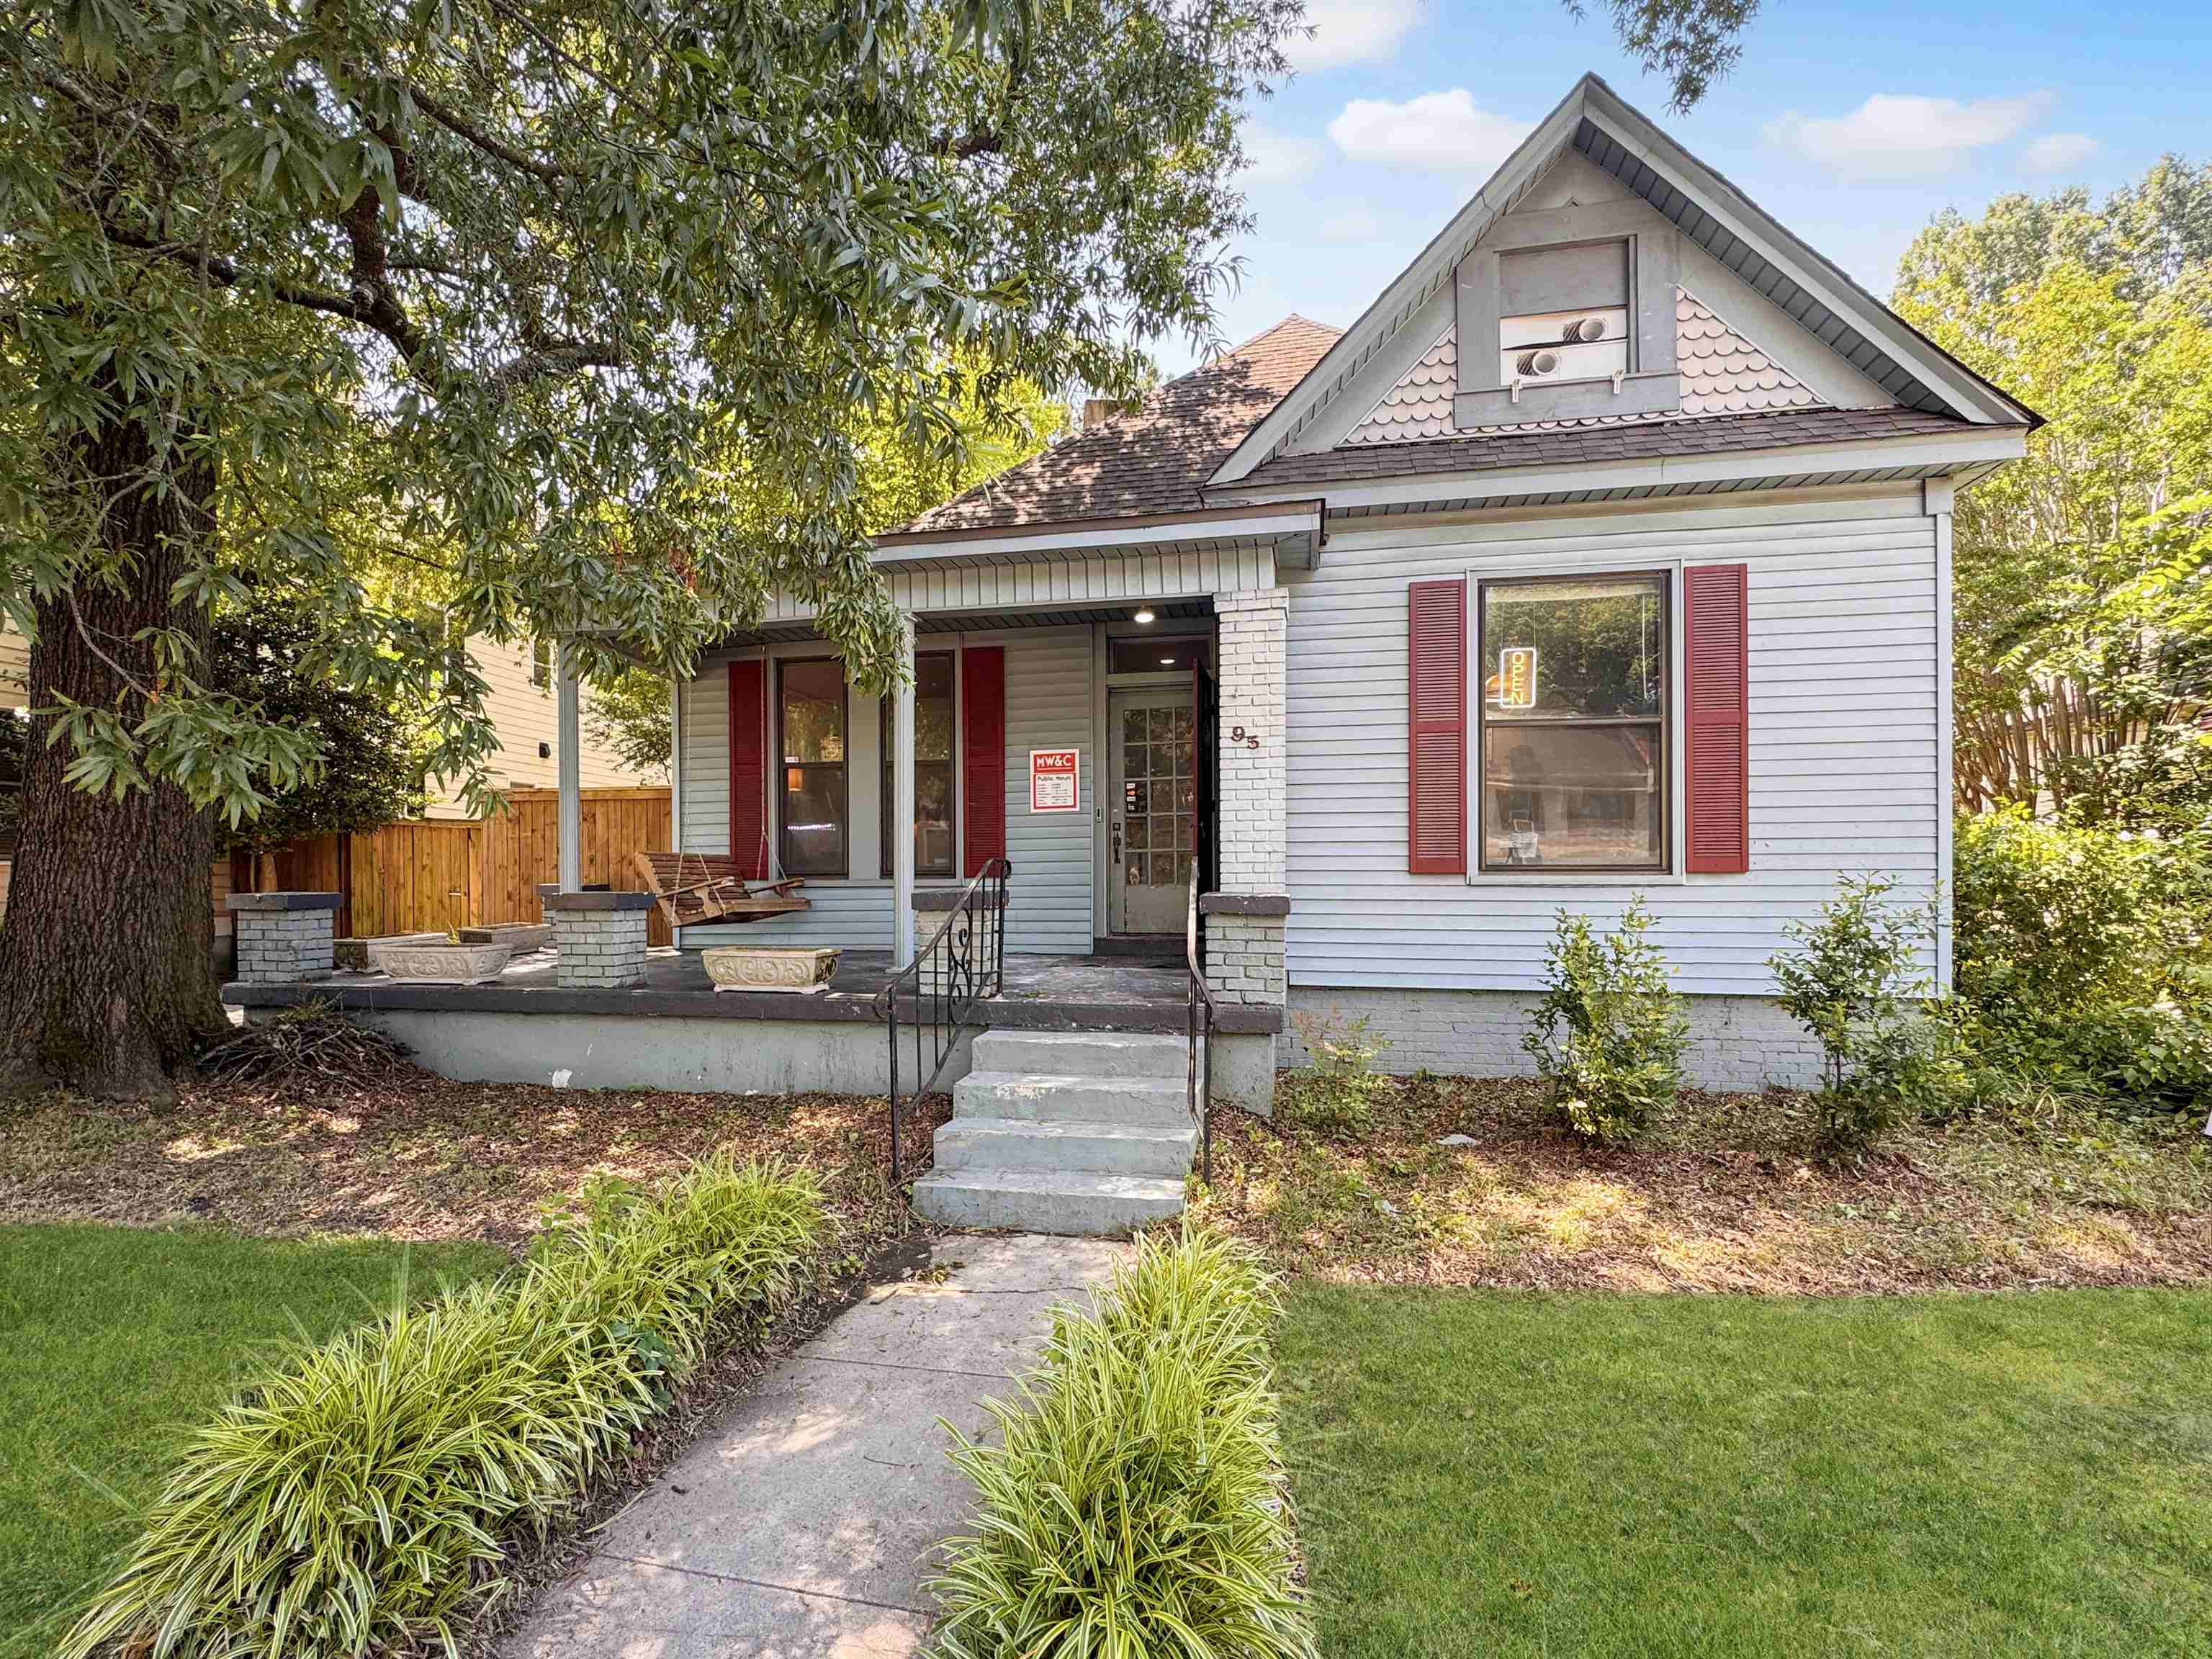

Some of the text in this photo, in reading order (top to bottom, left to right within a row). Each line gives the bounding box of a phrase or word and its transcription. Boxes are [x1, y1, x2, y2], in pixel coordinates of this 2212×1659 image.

[1511, 652, 1524, 703] OPEN
[1231, 727, 1259, 749] 95
[1036, 755, 1072, 768] MW&C
